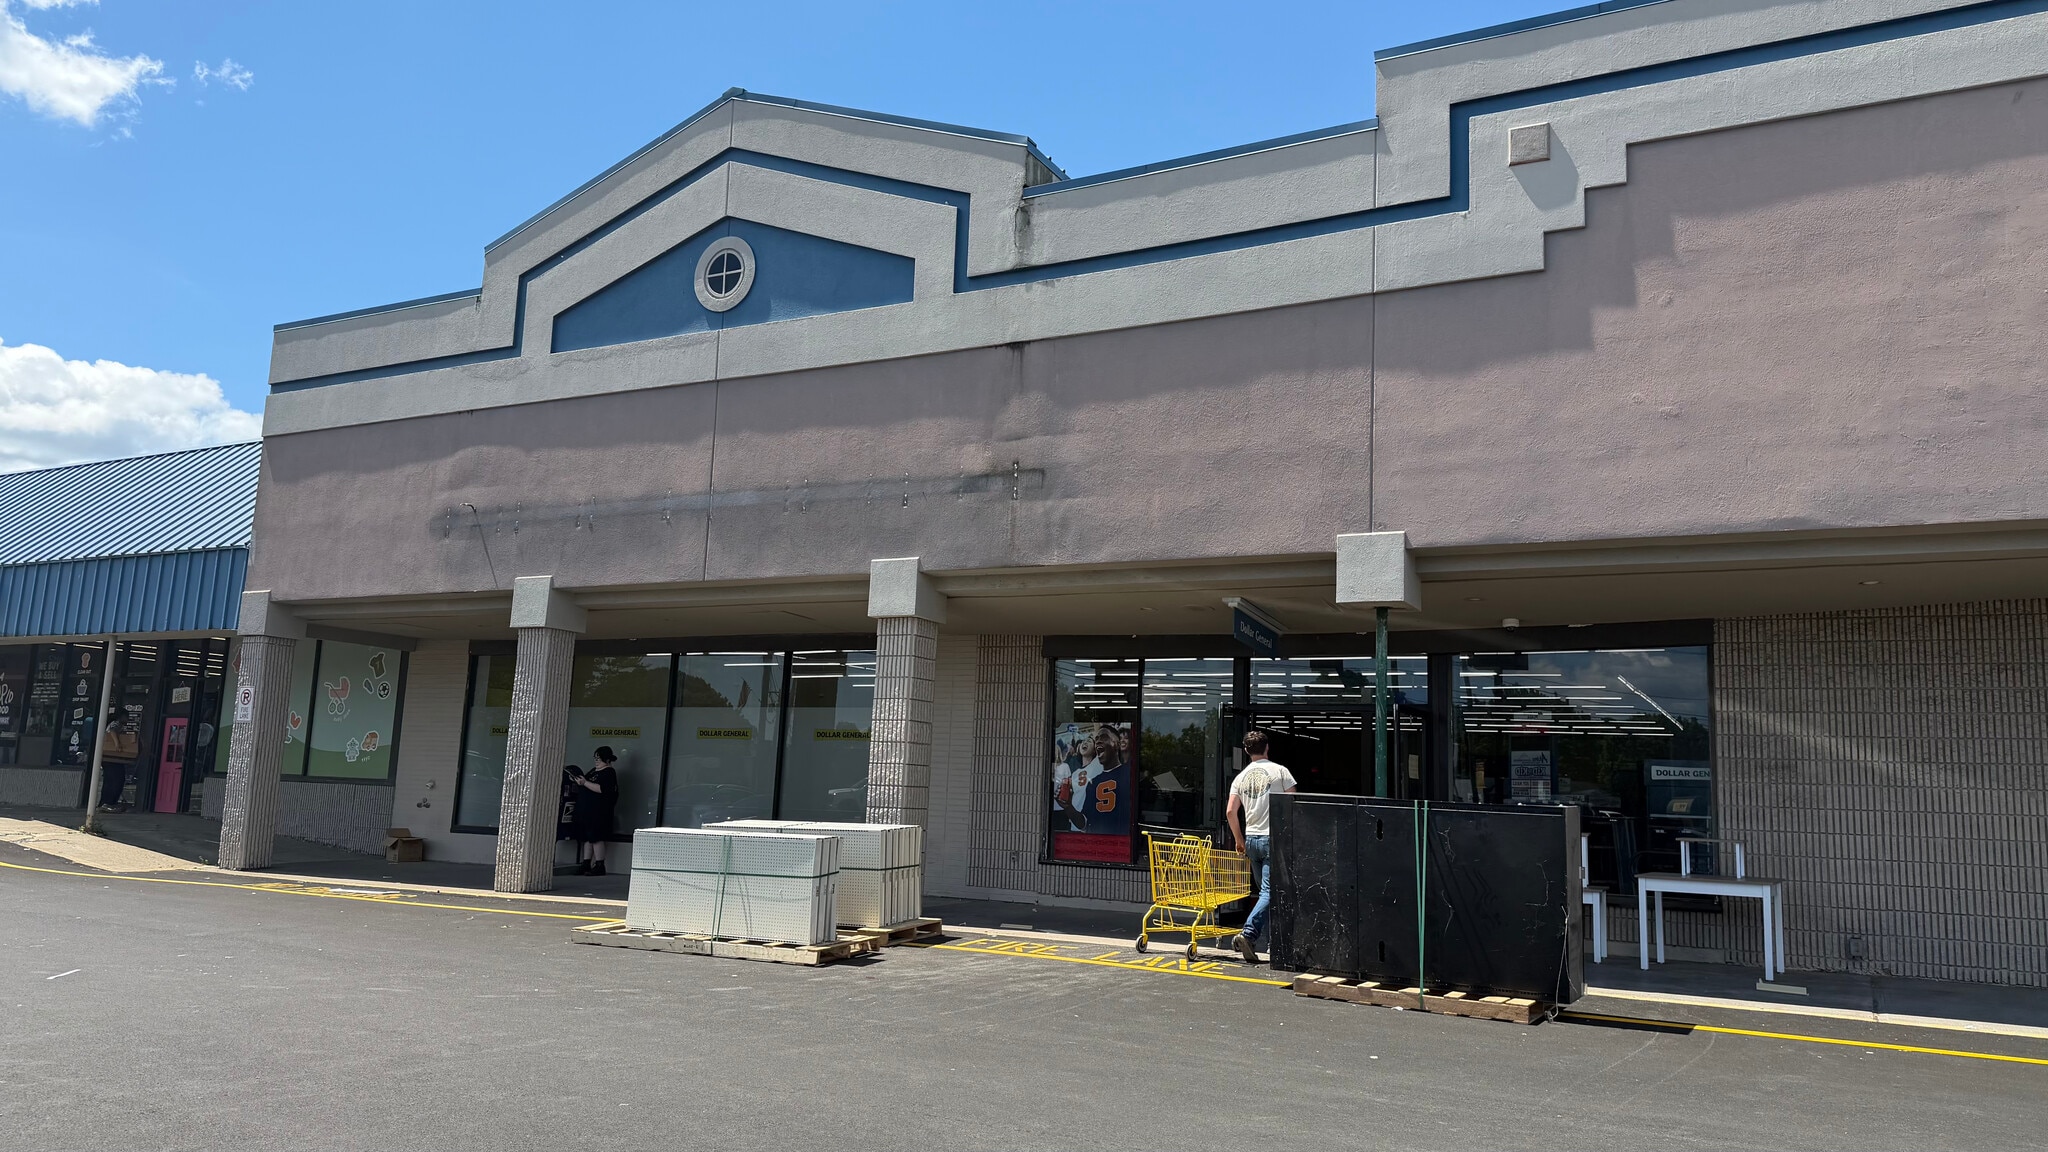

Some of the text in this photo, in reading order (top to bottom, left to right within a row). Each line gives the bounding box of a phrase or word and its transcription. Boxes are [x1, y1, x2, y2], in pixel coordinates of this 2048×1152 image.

[1240, 620, 1273, 649] Dollar General
[816, 731, 871, 739] DOLLAR GENERAL
[1078, 770, 1088, 786] S
[1656, 769, 1711, 778] DOLLAR GEN
[1095, 779, 1117, 813] S
[957, 938, 1243, 975] FIRE LANE
